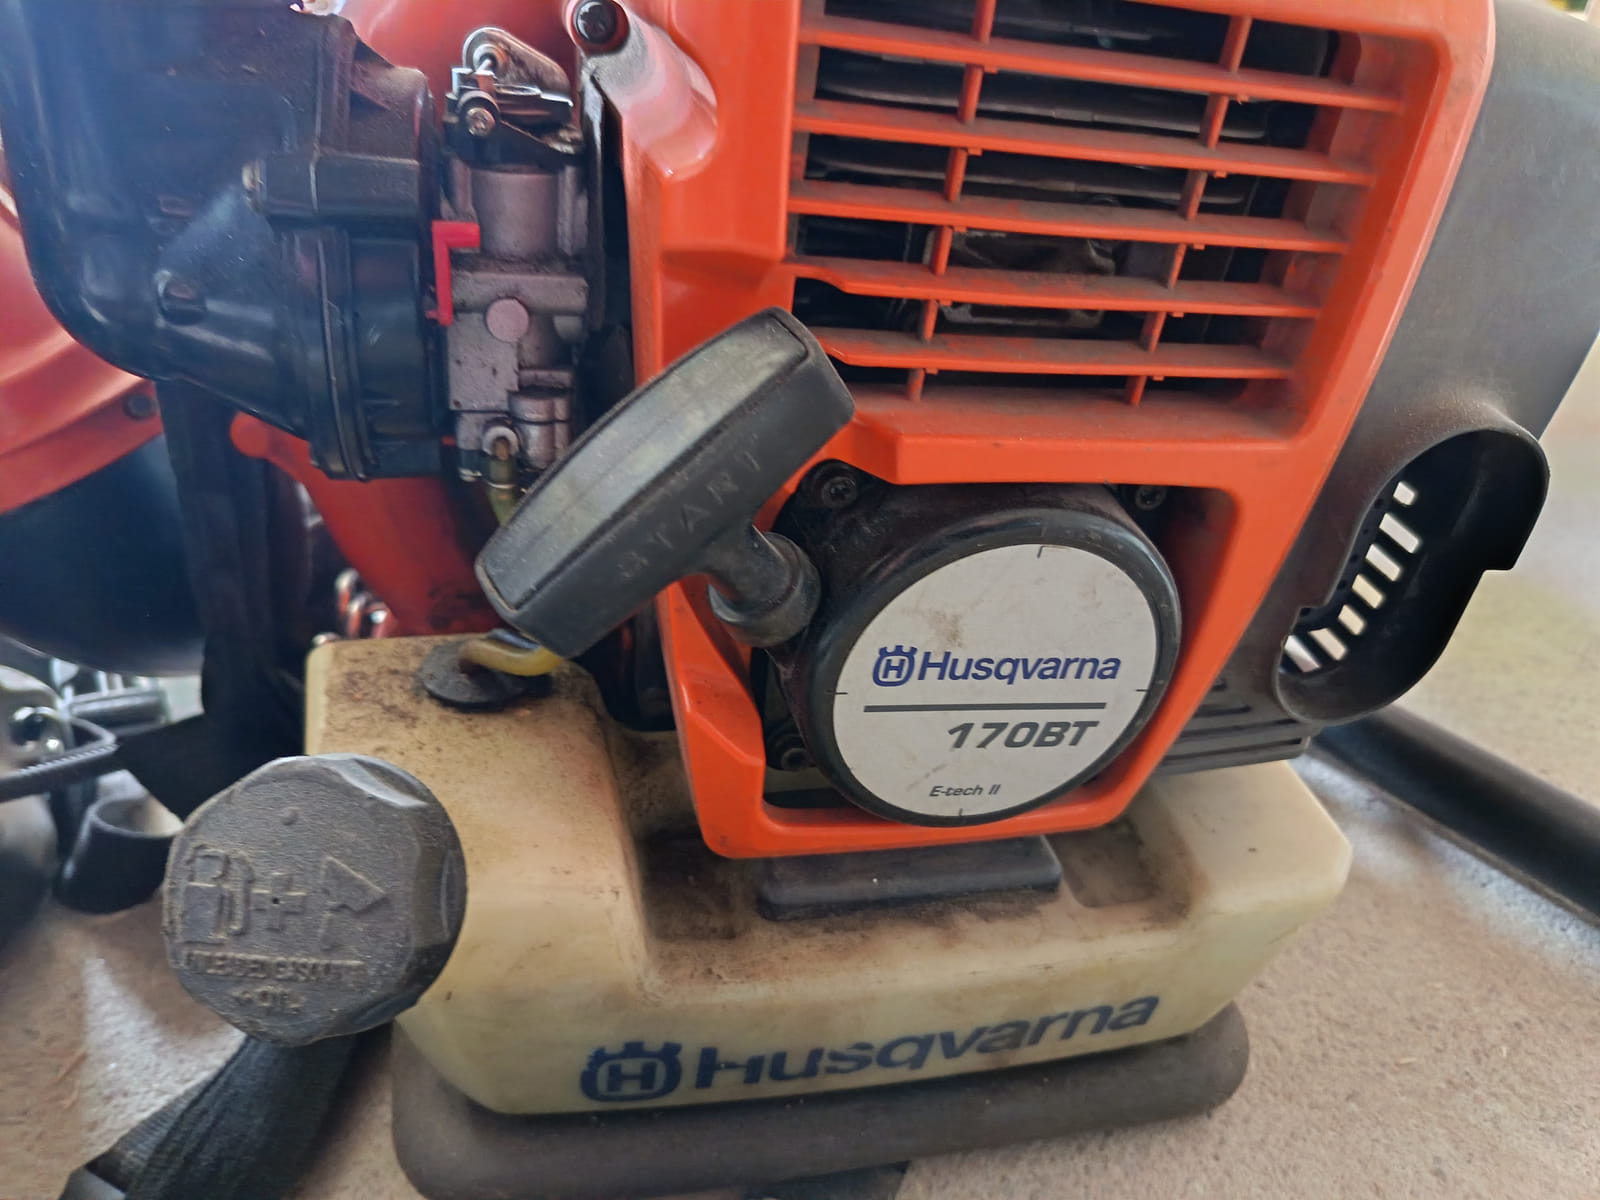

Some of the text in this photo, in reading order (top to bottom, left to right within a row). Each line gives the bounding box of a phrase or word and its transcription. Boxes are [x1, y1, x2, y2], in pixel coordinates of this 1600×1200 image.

[917, 651, 1121, 685] Husqvarna
[947, 720, 1100, 749] 170BT
[929, 785, 983, 797] E-tech
[694, 996, 1160, 1089] Husqvarna
